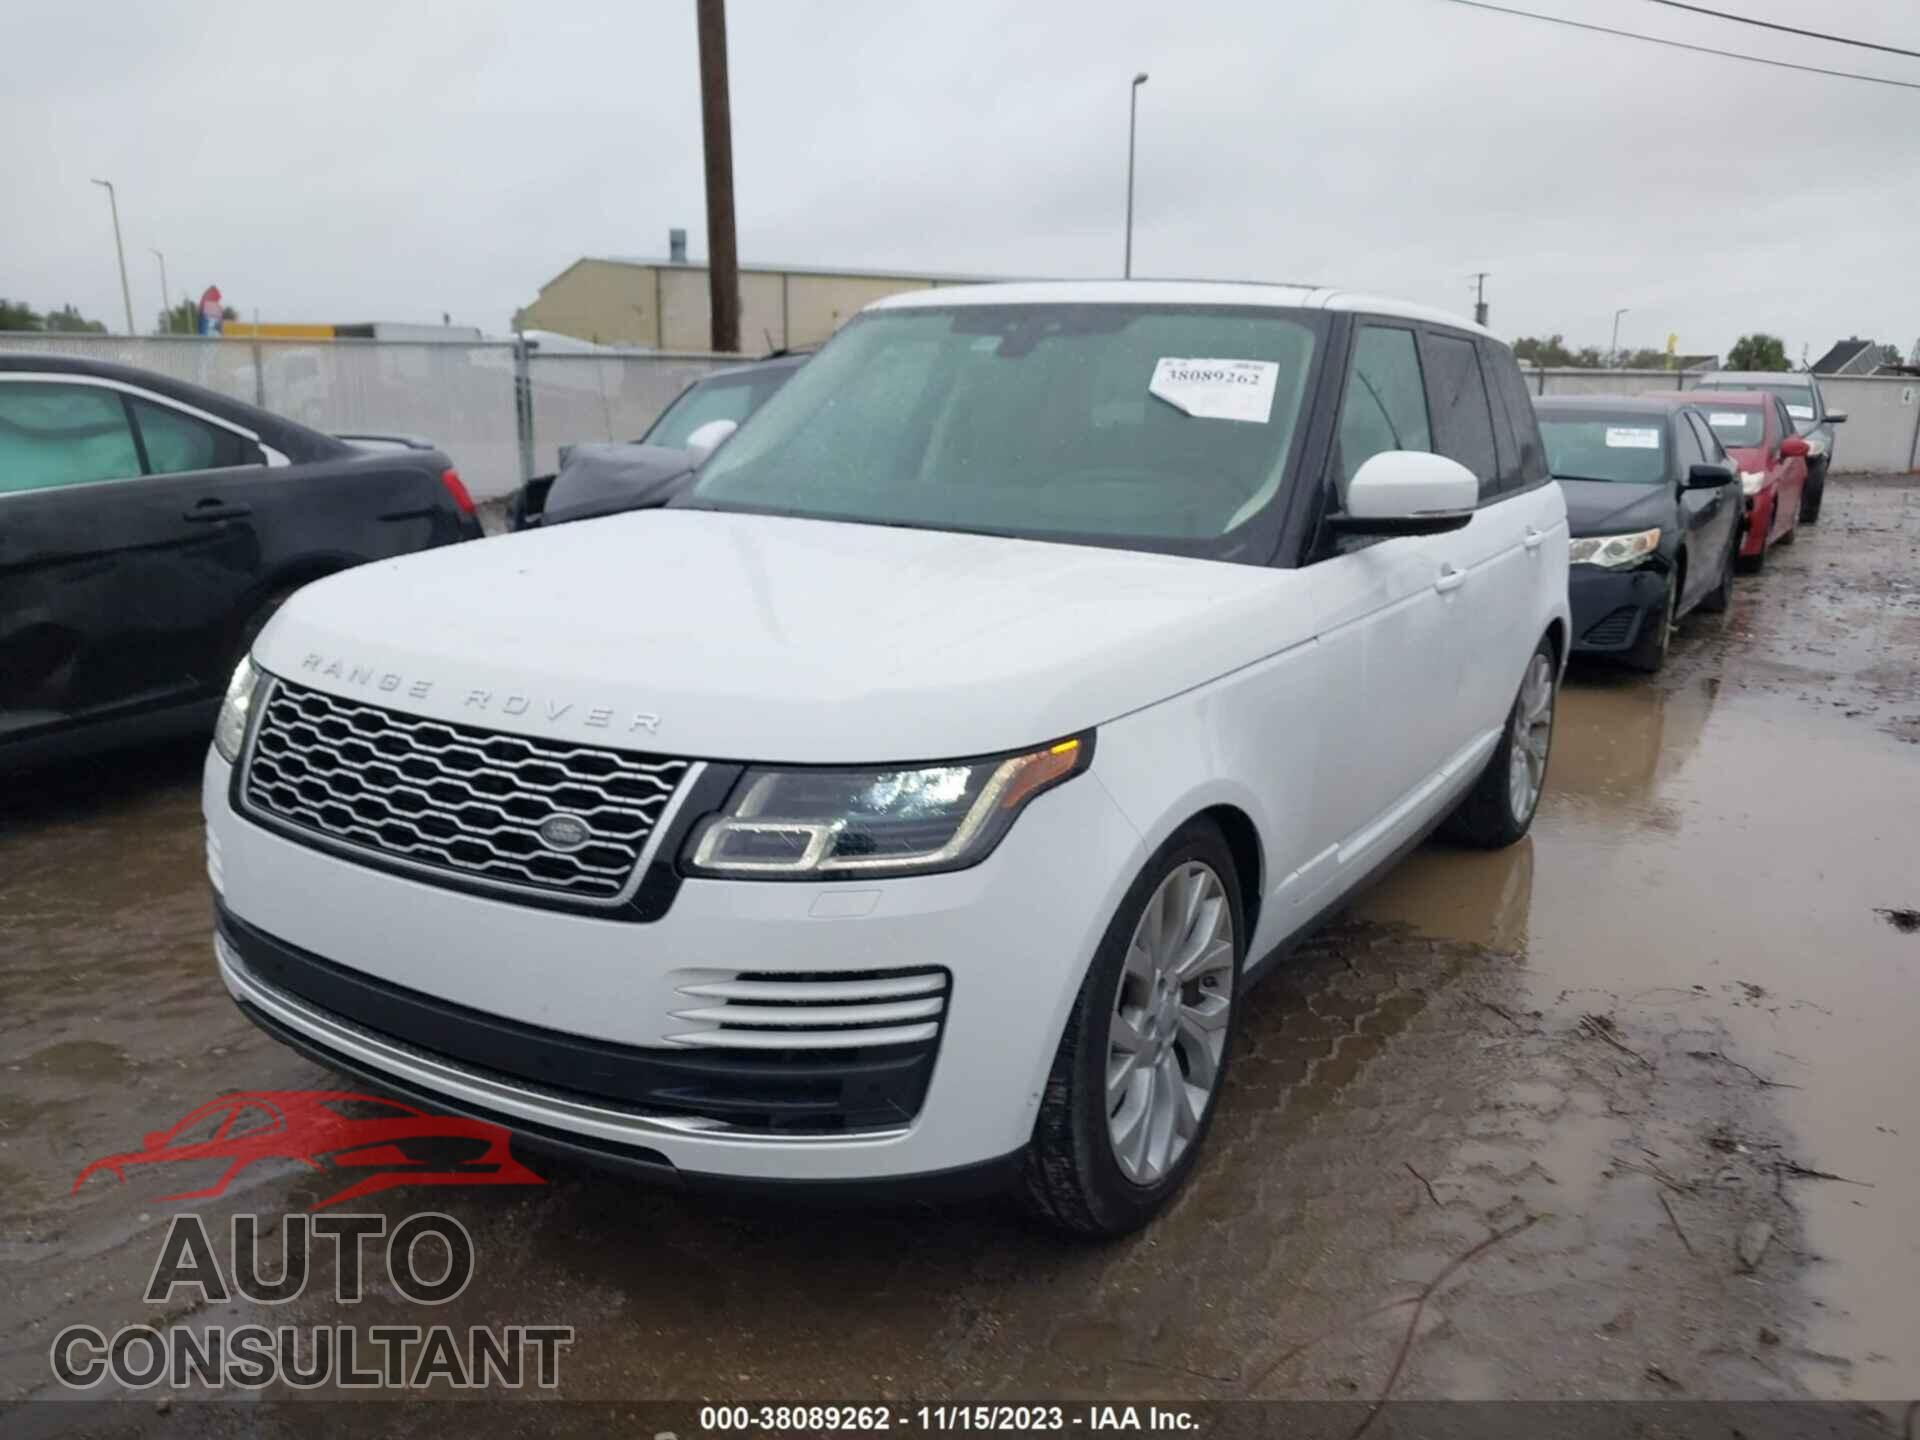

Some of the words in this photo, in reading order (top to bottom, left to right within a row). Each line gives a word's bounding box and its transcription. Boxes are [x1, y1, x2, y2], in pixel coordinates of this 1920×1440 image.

[1168, 369, 1260, 385] 38089262
[301, 652, 434, 700] RANGE
[464, 689, 663, 737] ROVER
